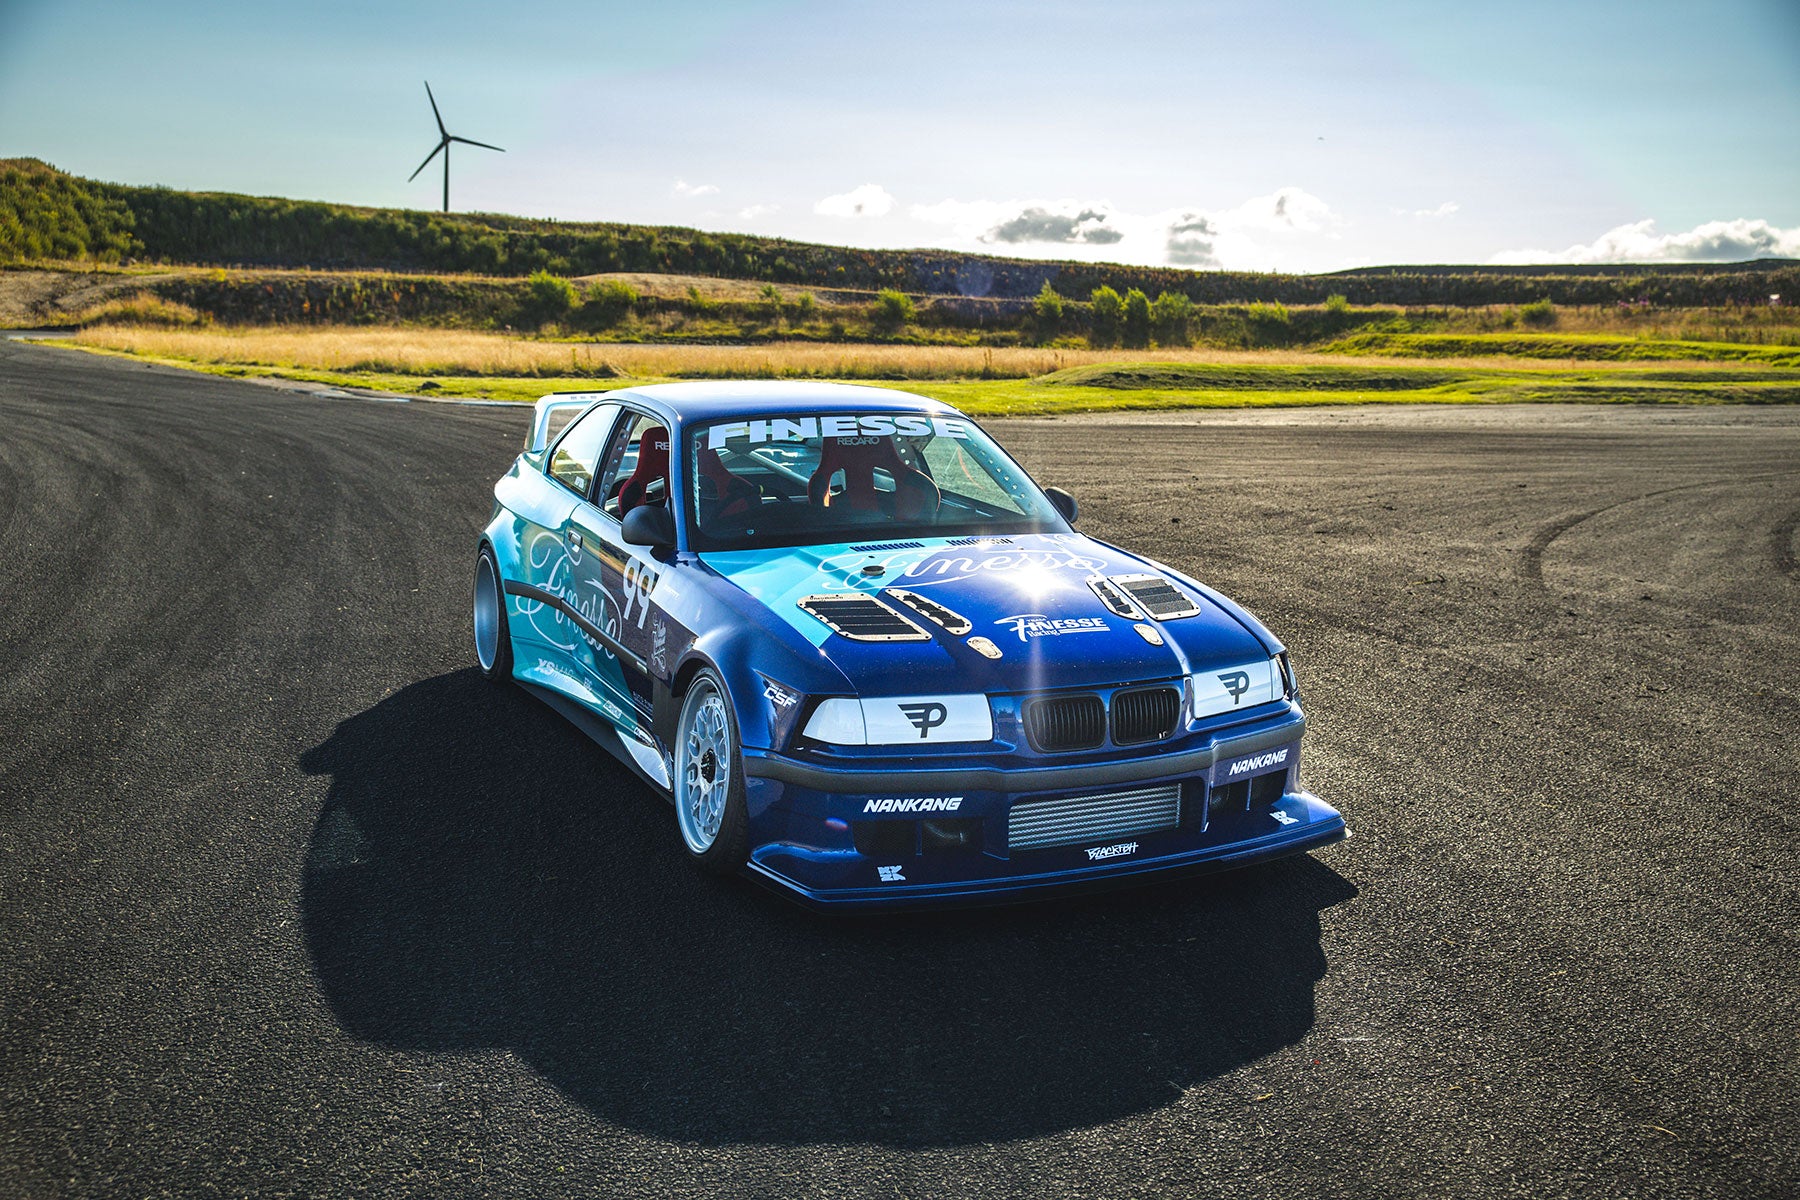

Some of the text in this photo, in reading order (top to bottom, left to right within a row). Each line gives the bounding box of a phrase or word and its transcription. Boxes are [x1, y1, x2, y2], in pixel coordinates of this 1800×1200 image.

[708, 415, 969, 450] FINESSE
[836, 435, 880, 447] RECARO
[622, 556, 657, 630] 99
[993, 614, 1107, 642] FINESSE
[763, 686, 797, 708] CSF
[1228, 748, 1289, 776] NANKANG
[862, 797, 963, 813] NANKANG
